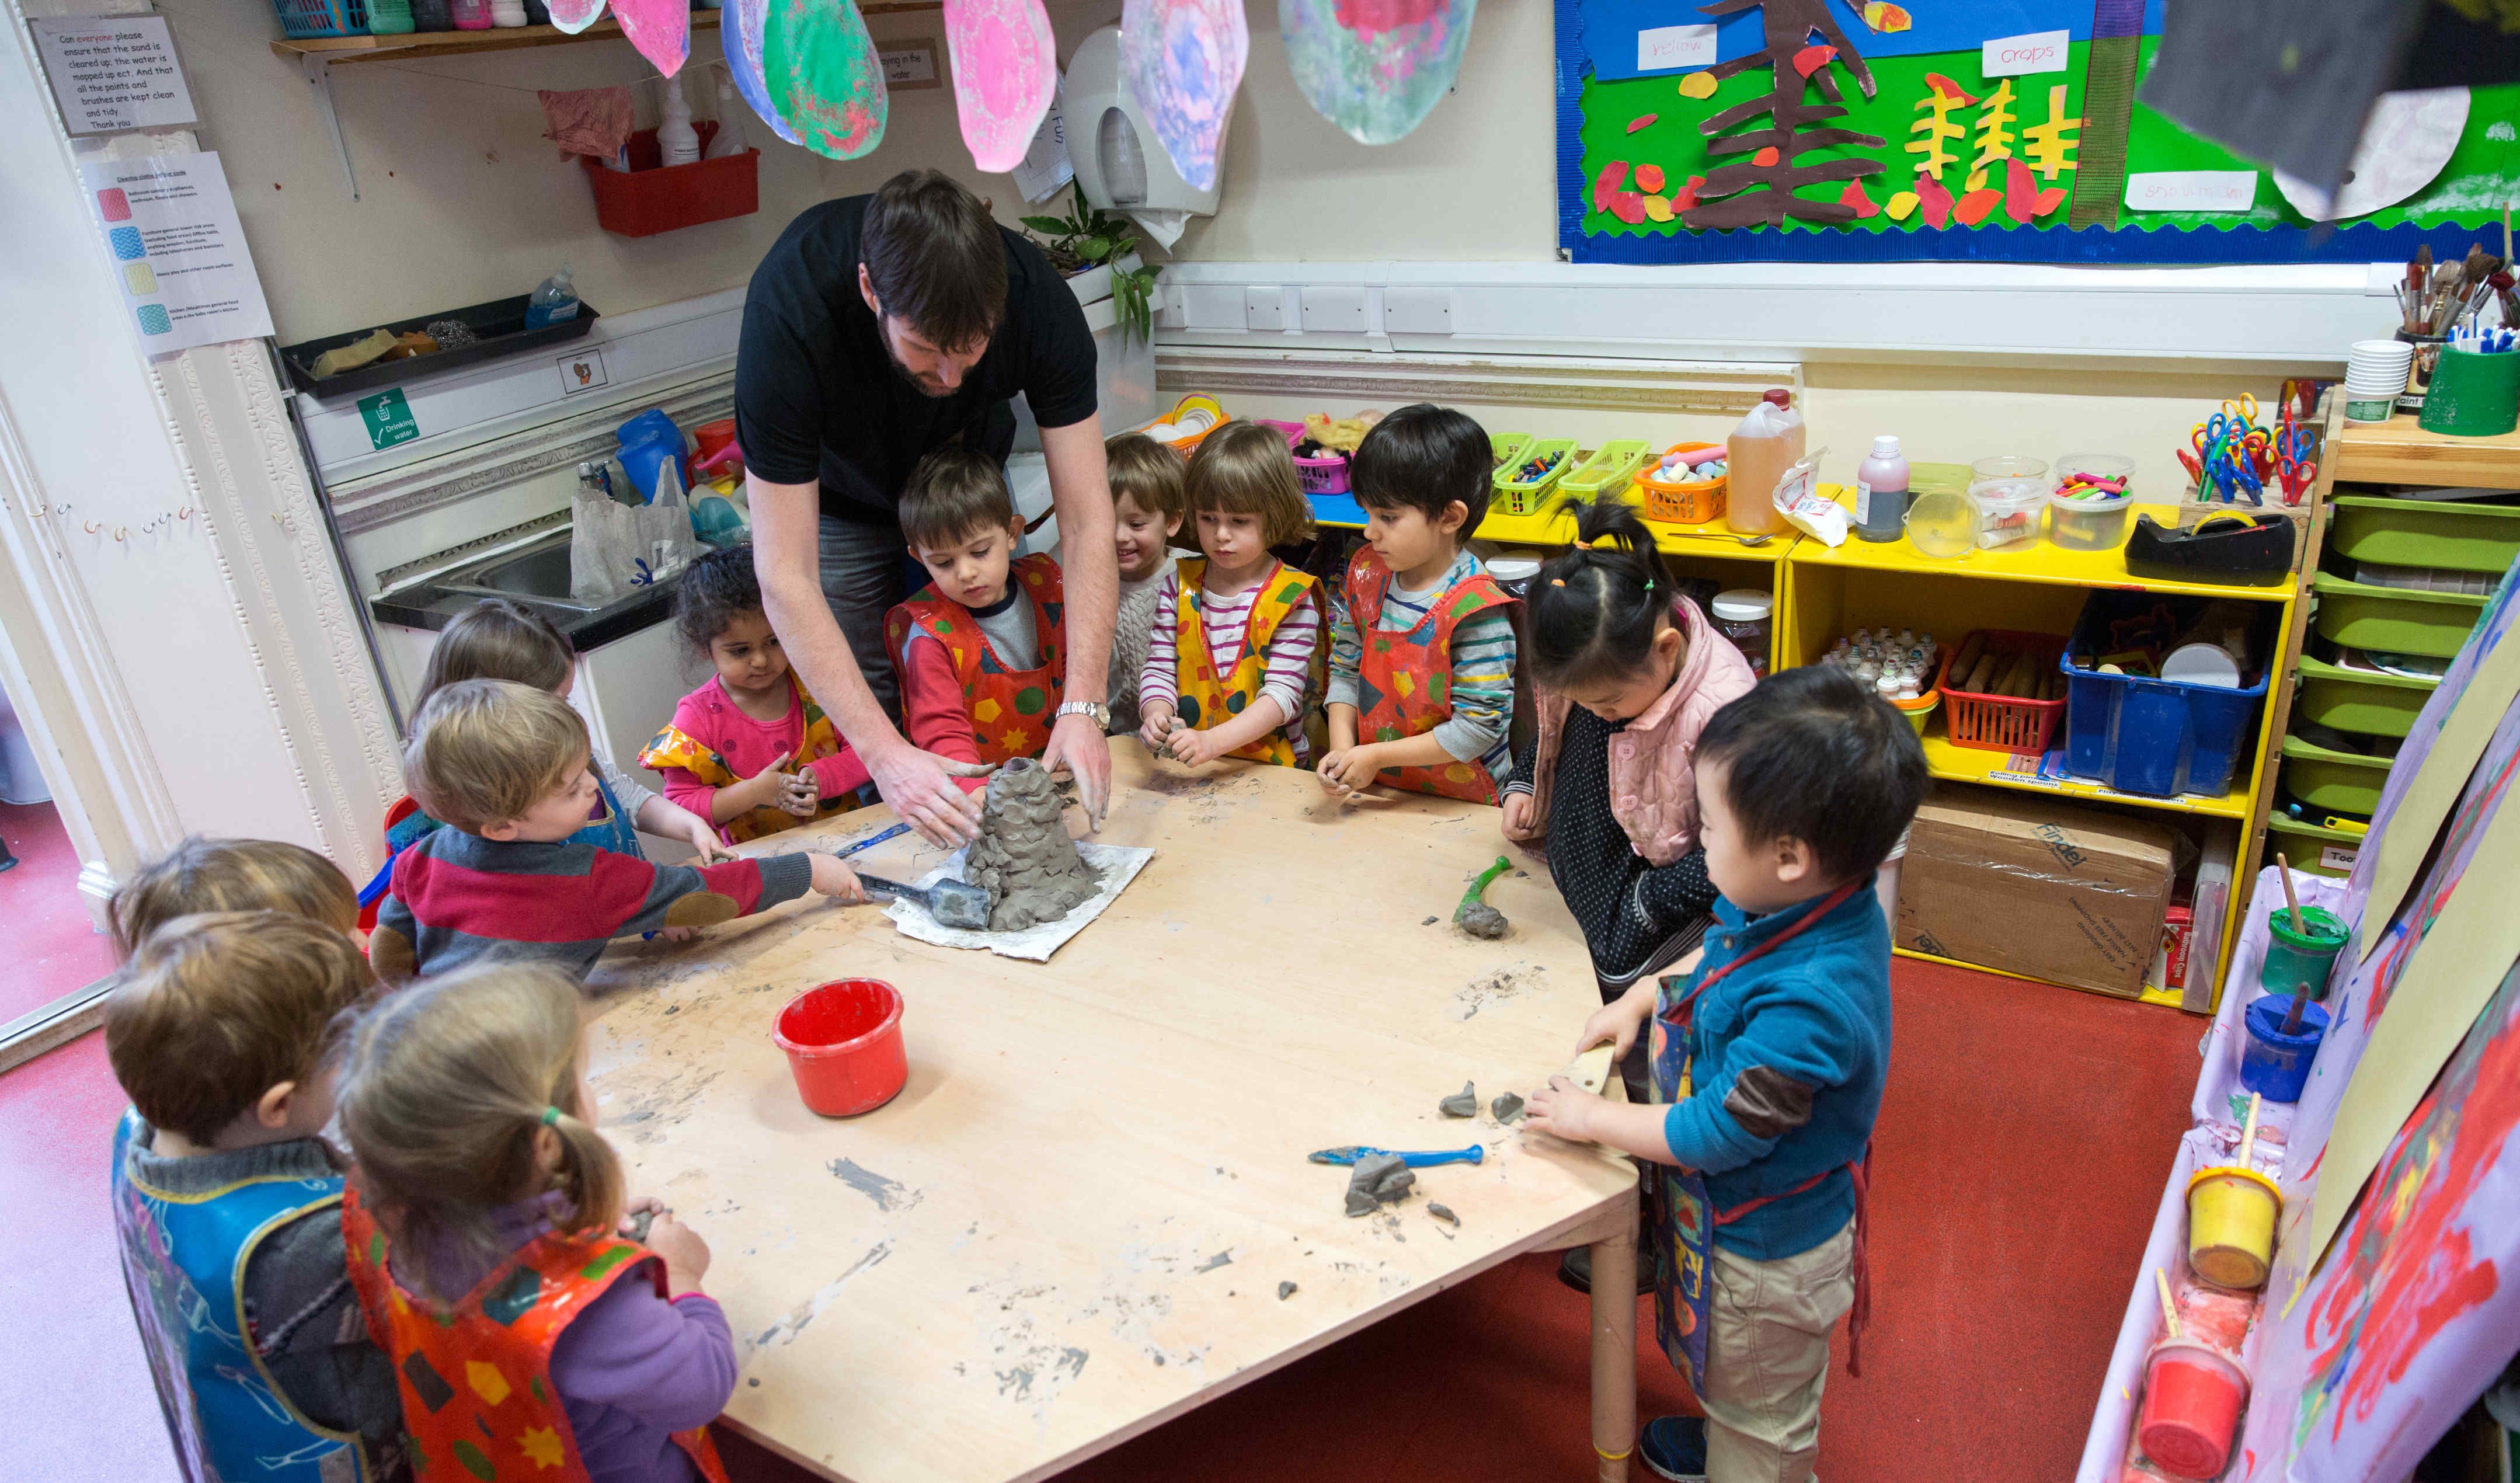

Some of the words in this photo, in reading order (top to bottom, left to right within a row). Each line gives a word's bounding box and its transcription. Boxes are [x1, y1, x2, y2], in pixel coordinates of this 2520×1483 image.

[60, 35, 75, 44] Can
[76, 34, 113, 44] everyone
[116, 32, 143, 43] please
[64, 48, 92, 56] ensure
[93, 46, 111, 54] that
[113, 45, 128, 53] the
[131, 43, 151, 51] sand
[153, 42, 161, 50] is
[2001, 46, 2054, 64] crops
[69, 60, 99, 68] cleared
[115, 57, 130, 65] the
[131, 55, 156, 64] water
[910, 52, 921, 62] the
[73, 71, 103, 82] mopped
[105, 71, 115, 80] up
[136, 67, 153, 76] And
[155, 66, 173, 75] that
[891, 71, 911, 79] water
[77, 85, 88, 93] all
[89, 84, 103, 92] the
[105, 82, 130, 92] paints
[132, 80, 147, 88] and
[81, 95, 113, 106] brushes
[131, 93, 150, 102] kept
[153, 90, 175, 99] clean
[86, 108, 100, 117] and
[102, 107, 121, 117] tidy.
[90, 120, 115, 130] Thank
[117, 119, 130, 127] you
[385, 419, 415, 433] Drinking
[394, 429, 412, 440] water
[1990, 770, 2018, 778] Rolling
[1990, 774, 2025, 782] Wooden
[2037, 823, 2087, 866] Findel
[2331, 851, 2357, 863] Too
[2178, 931, 2191, 962] Bathroom
[2174, 962, 2185, 978] Cups
